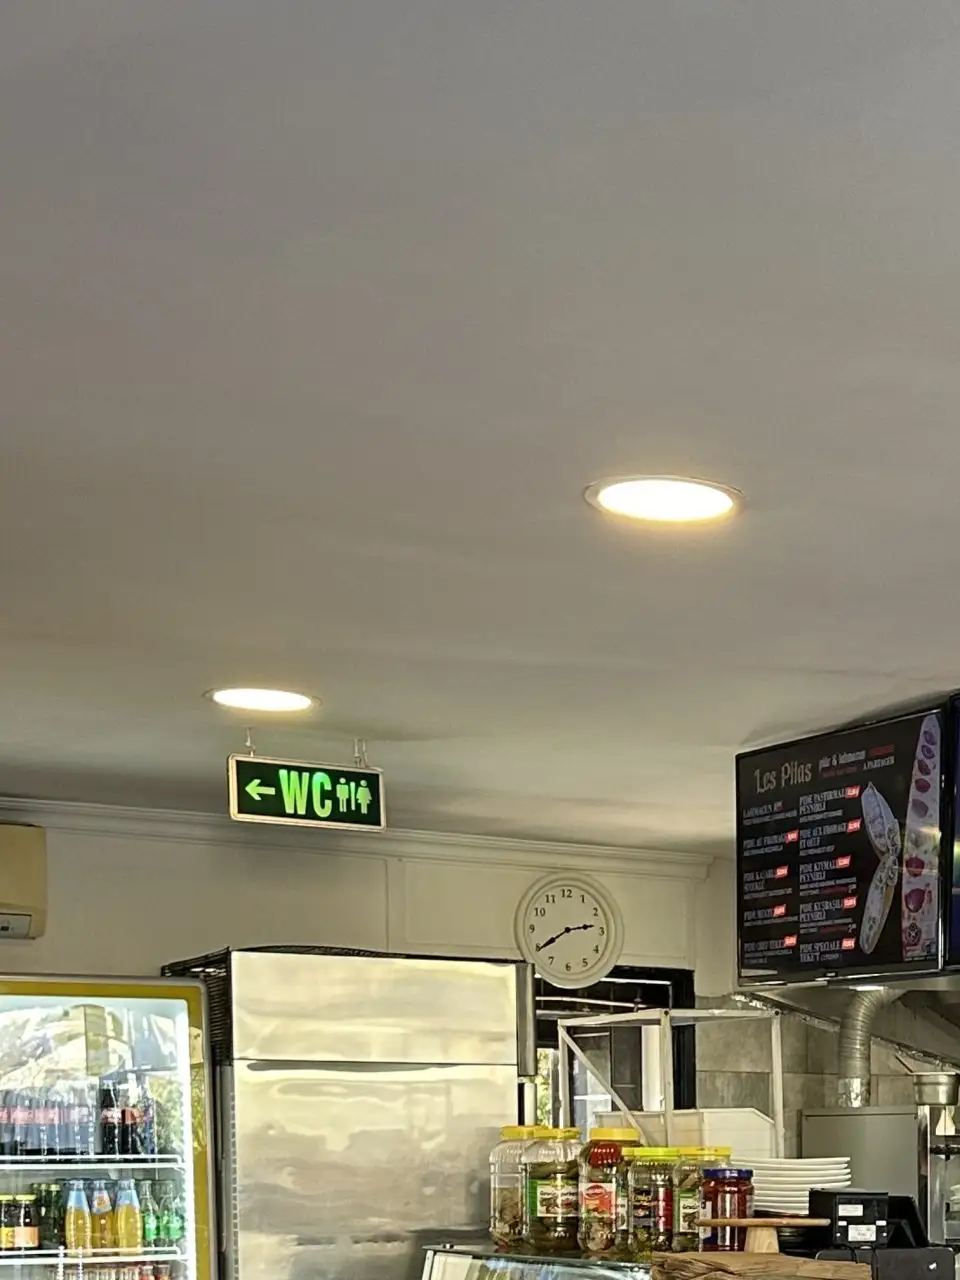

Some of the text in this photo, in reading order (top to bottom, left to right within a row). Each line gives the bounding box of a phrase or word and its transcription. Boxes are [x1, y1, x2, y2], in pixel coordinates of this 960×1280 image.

[278, 768, 333, 818] WC
[561, 889, 572, 898] 12
[545, 894, 556, 903] 11
[580, 894, 585, 903] 1
[534, 907, 546, 917] 10
[593, 907, 598, 917] 2
[529, 924, 535, 933] 9
[599, 927, 605, 936] 3
[593, 945, 599, 954] 4
[548, 956, 554, 965] 7
[582, 958, 588, 967] 5
[566, 962, 571, 971] 6
